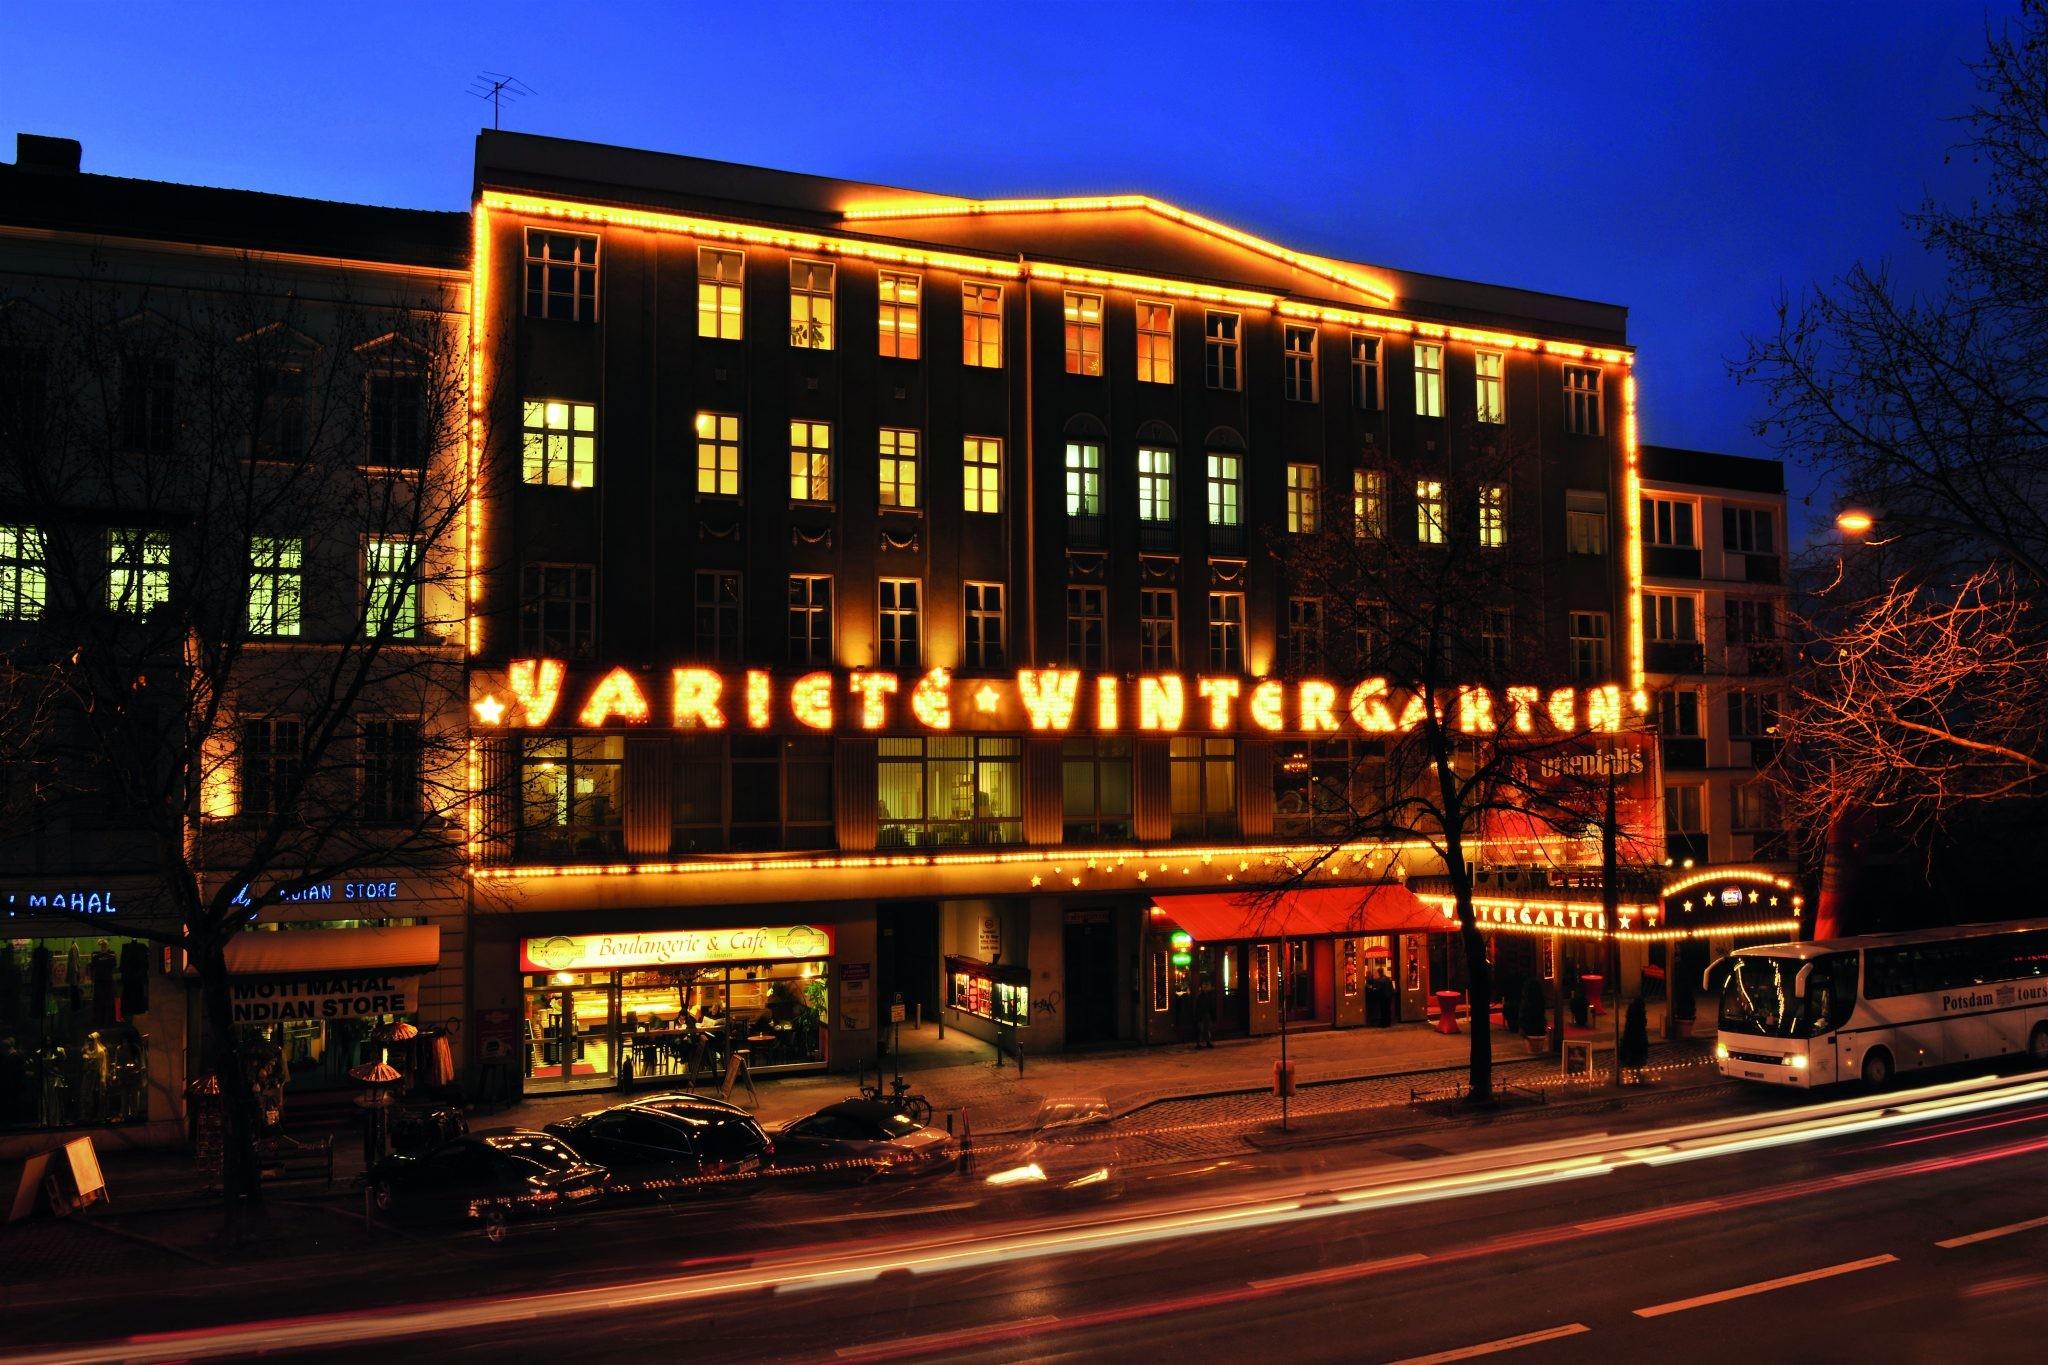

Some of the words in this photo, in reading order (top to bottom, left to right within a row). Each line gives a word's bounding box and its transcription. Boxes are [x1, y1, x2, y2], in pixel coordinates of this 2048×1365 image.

[1017, 669, 1622, 733] WINTERGARTEN
[29, 892, 116, 914] MAHAL
[346, 882, 397, 898] STORE
[1442, 899, 1606, 930] WTERGARTEN
[600, 934, 700, 962] Boulangerie
[706, 937, 720, 951] &
[307, 976, 396, 996] MAHAL
[1942, 991, 1994, 1011] Potsdam
[2017, 984, 2048, 1001] tours
[234, 1000, 315, 1021] NDIAN
[322, 993, 405, 1017] STORE
